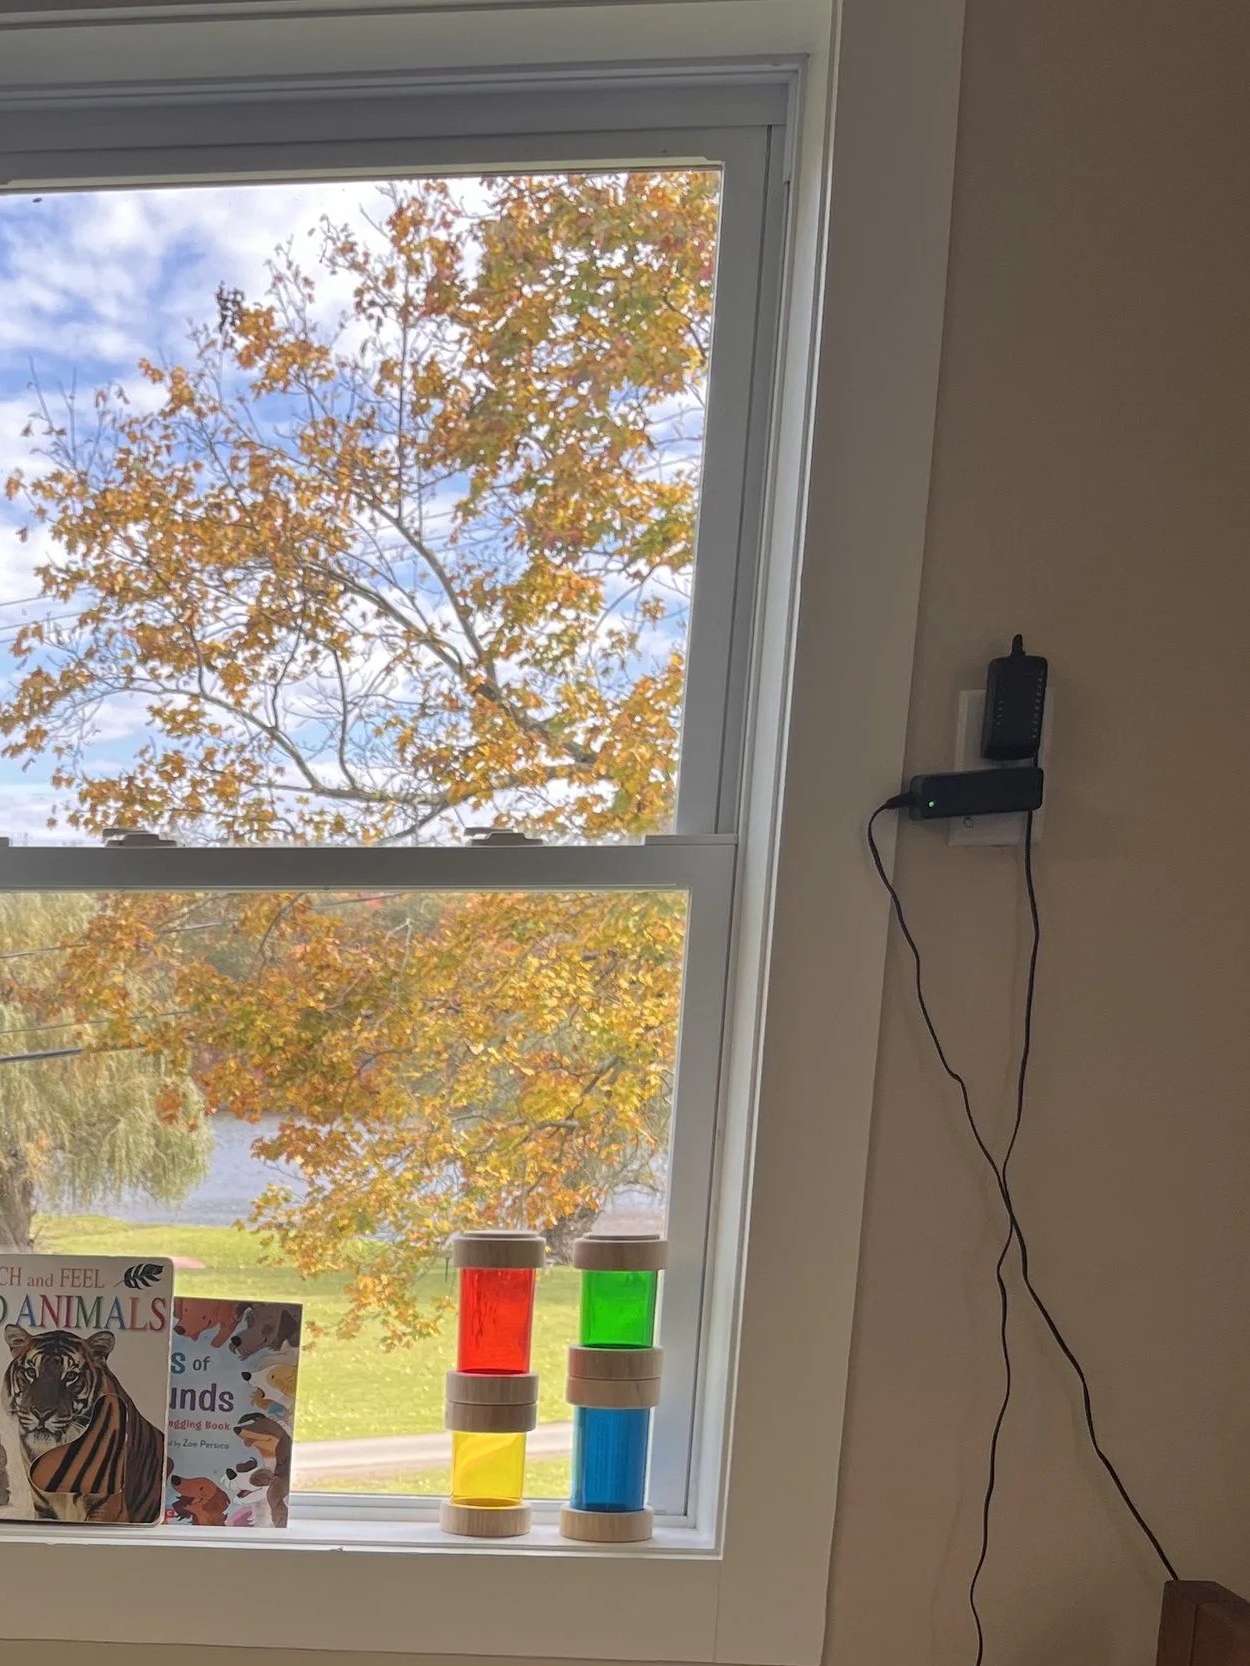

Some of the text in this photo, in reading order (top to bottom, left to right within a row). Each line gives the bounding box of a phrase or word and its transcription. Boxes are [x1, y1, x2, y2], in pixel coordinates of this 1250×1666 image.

[26, 1273, 54, 1288] and
[60, 1268, 105, 1289] FEEL
[15, 1292, 166, 1333] ANIMALS
[192, 1356, 210, 1371] of
[205, 1420, 231, 1431] Book
